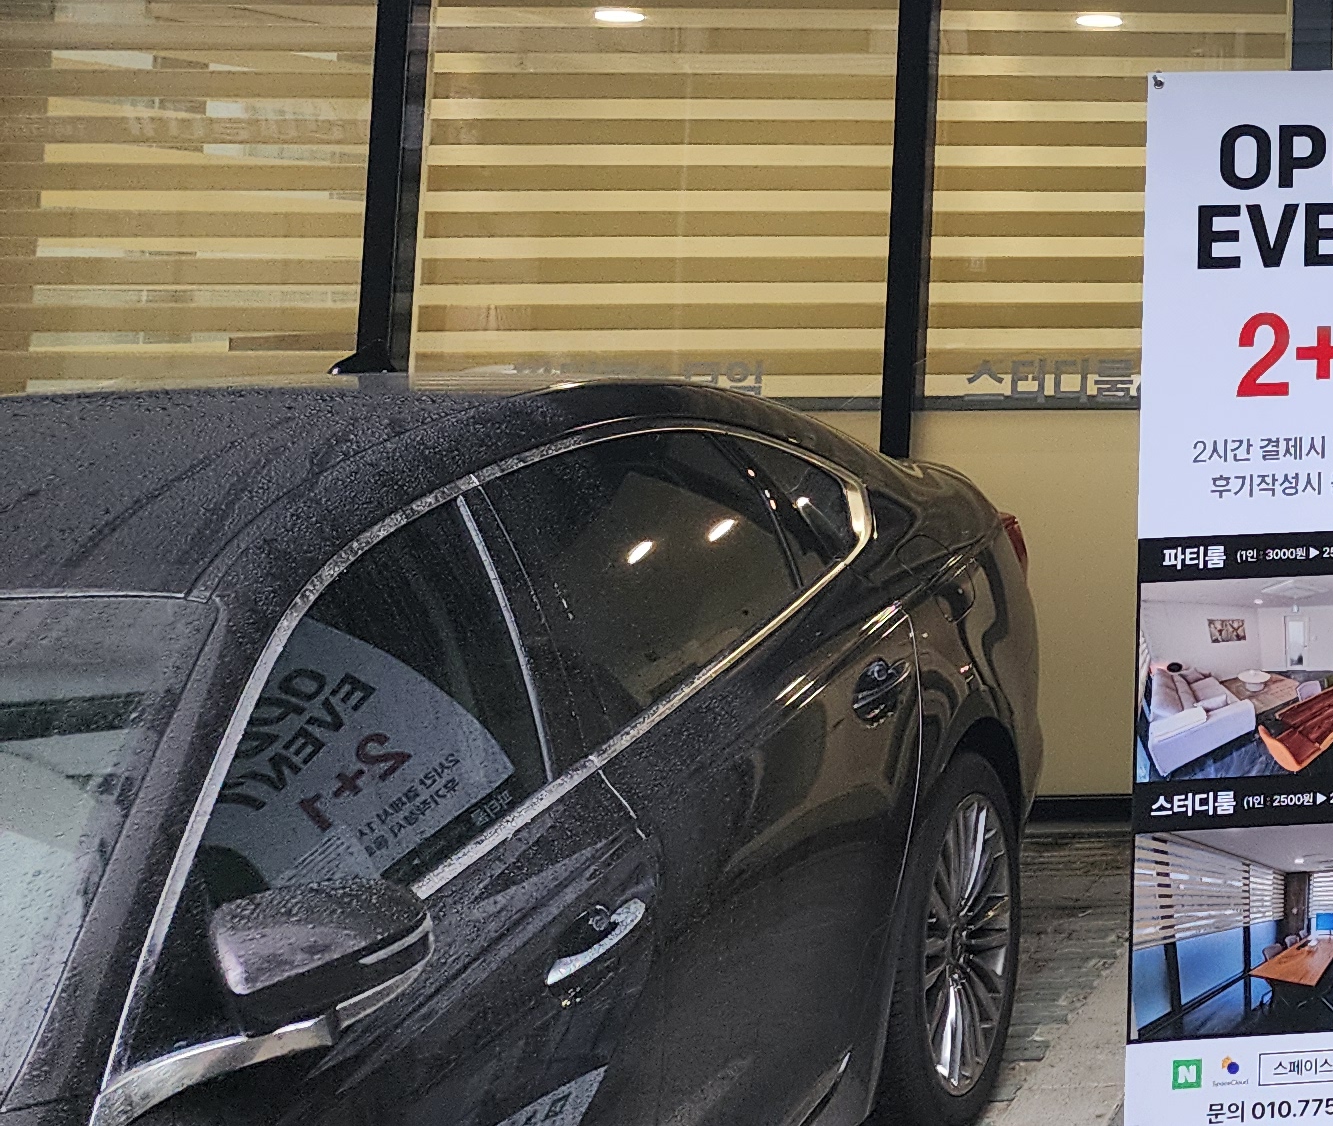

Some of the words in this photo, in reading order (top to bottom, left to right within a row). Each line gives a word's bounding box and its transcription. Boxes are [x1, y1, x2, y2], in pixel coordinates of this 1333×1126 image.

[964, 358, 1140, 403] 스터디룸
[1192, 438, 1253, 464] 2시간
[1259, 435, 1326, 461] 결제시
[1210, 471, 1322, 499] 후기작성시
[1162, 545, 1227, 570] 파티룸
[1265, 546, 1306, 561] 3000원
[1150, 791, 1236, 817] 스터디룸
[1273, 793, 1313, 808] 2500원
[1273, 1058, 1333, 1076] 스페이스
[1206, 1100, 1245, 1125] 문의
